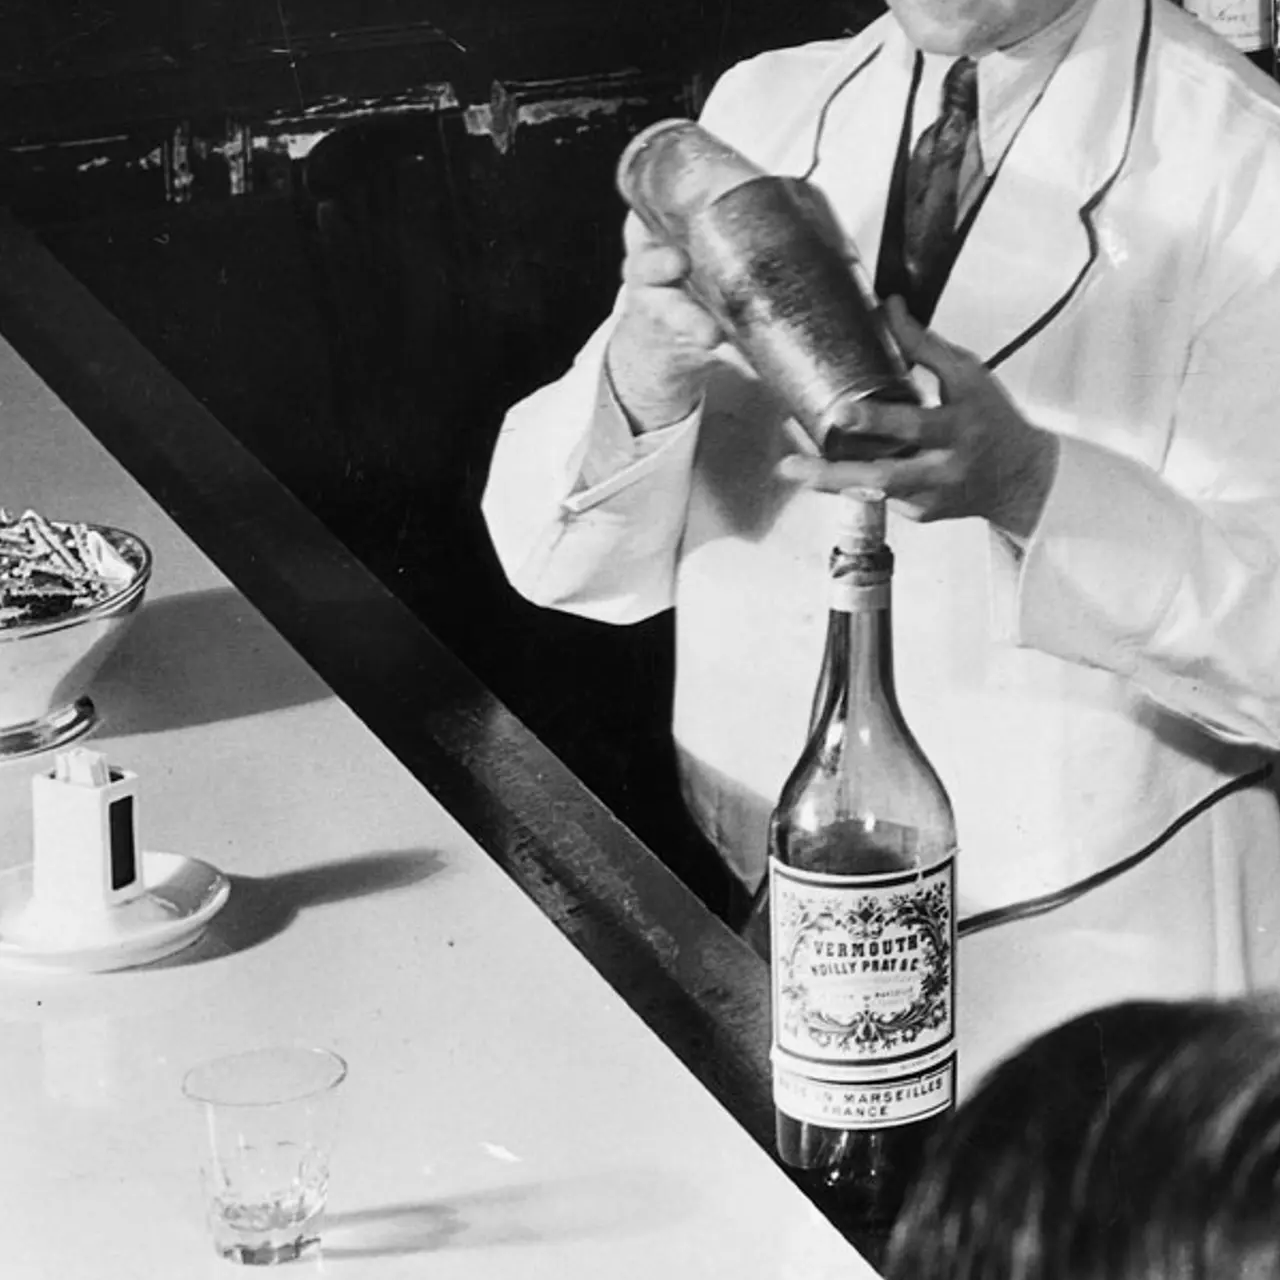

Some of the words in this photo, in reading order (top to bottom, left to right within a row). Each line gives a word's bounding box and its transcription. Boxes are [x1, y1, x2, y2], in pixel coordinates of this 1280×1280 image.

[813, 934, 918, 958] VERMOUTH
[844, 1077, 944, 1104] MARSEILLES
[821, 1104, 889, 1117] FRANCE
